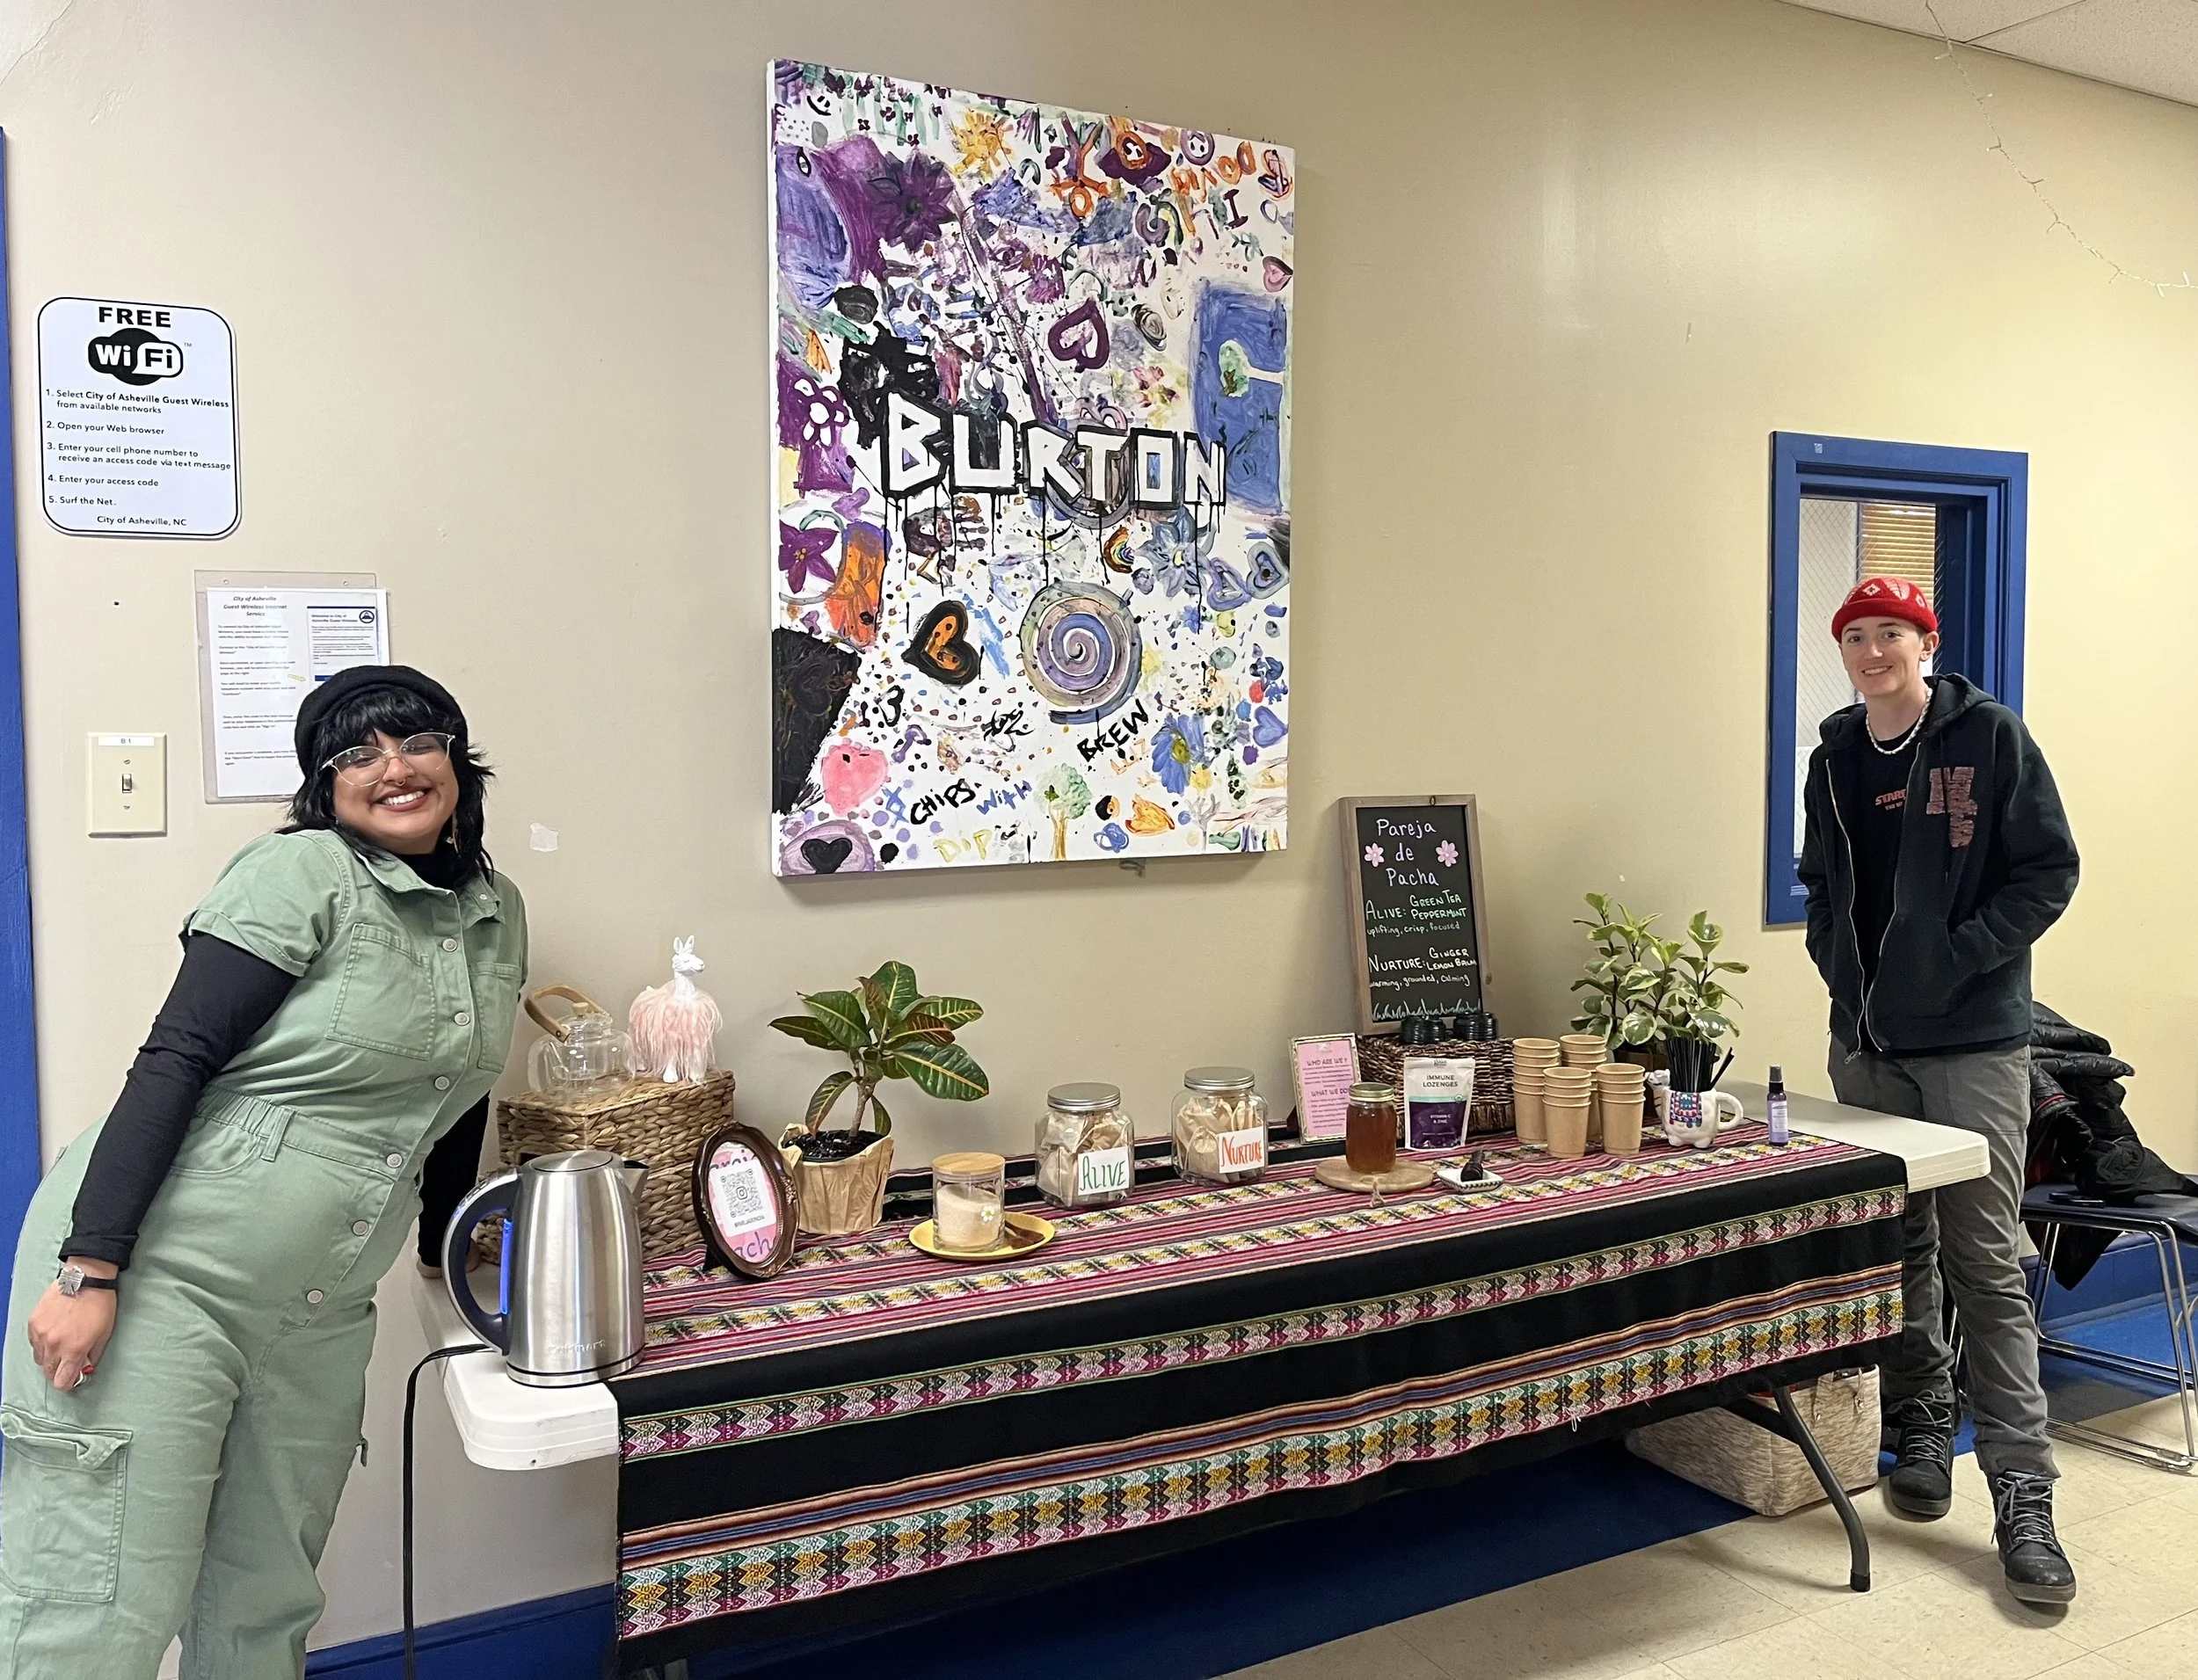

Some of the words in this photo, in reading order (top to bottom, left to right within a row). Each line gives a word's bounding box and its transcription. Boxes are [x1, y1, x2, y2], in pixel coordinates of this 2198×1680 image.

[98, 306, 171, 328] FREE
[56, 389, 84, 399] Select
[85, 392, 103, 401] City
[119, 393, 160, 404] Asheville
[163, 396, 189, 405] Guest
[191, 398, 229, 408] Wireless
[80, 402, 119, 411] available
[122, 404, 162, 414] networks
[57, 422, 83, 433] Open
[106, 424, 127, 433] Web
[129, 425, 164, 435] browser
[106, 445, 121, 454] cell
[124, 447, 151, 456] phone
[154, 448, 186, 457] number
[880, 389, 1228, 511] BURTON
[106, 456, 134, 465] access
[175, 459, 191, 468] text
[193, 461, 231, 471] message
[60, 496, 78, 505] Surf
[80, 497, 94, 505] the
[97, 516, 115, 526] City
[128, 517, 171, 527] Asheville,
[1076, 698, 1150, 763] BREW
[910, 778, 977, 825] CHIPS
[1377, 818, 1437, 839] Pareja
[1395, 842, 1414, 862] de
[1386, 868, 1439, 887] Pacha
[1409, 895, 1445, 907] GREEN
[1442, 890, 1461, 904] TEA
[1365, 899, 1406, 920] ALIVE:
[1411, 907, 1467, 920] PEPPERMINT
[1367, 925, 1403, 937] uplifting,
[1430, 921, 1459, 930] focused
[1429, 948, 1469, 958] GINGER
[1369, 954, 1426, 973] NURTURE:
[1426, 961, 1454, 971] LEMON
[1403, 974, 1439, 986] grounded,
[1220, 1136, 1263, 1167] NURTURE
